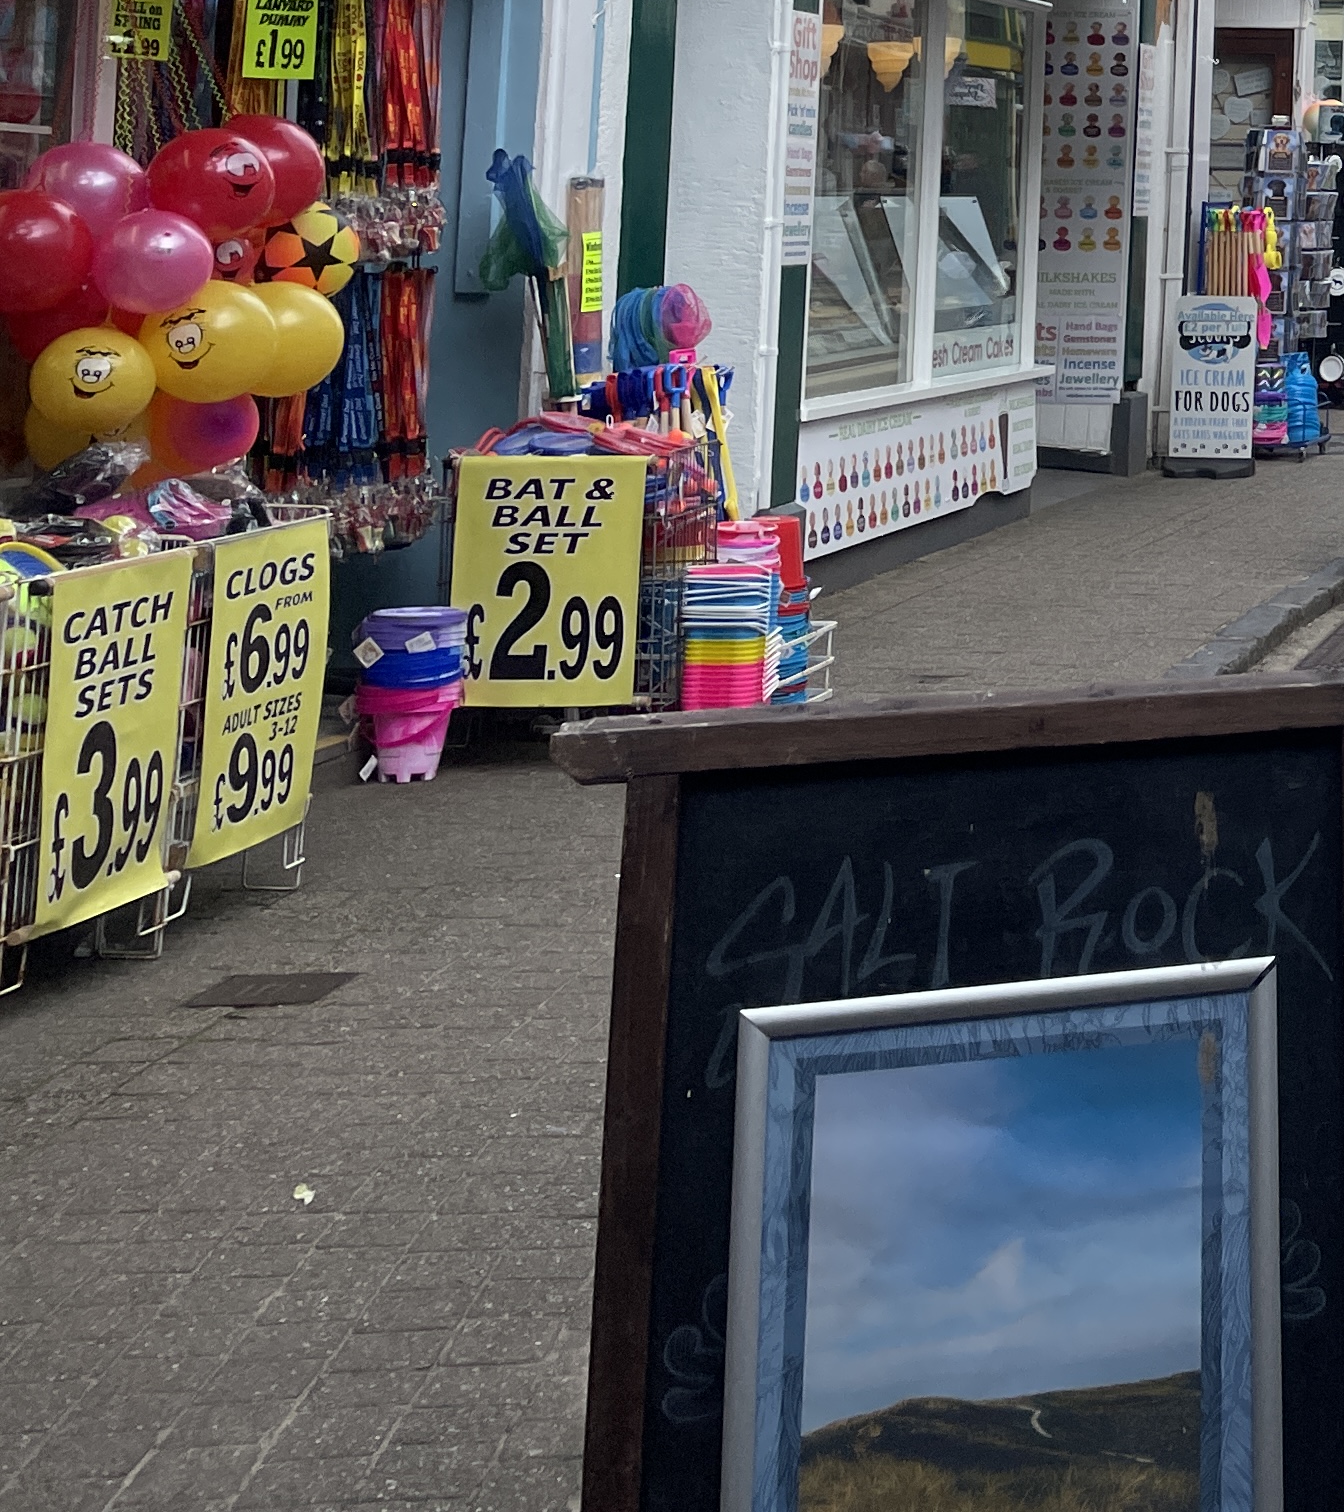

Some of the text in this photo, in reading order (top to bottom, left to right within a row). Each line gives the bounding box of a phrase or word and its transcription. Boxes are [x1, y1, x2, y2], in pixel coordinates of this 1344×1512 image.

[255, 0, 314, 12] LANYARD
[114, 15, 161, 30] STING
[259, 14, 310, 27] DUMMY
[793, 17, 817, 51] Gift
[789, 50, 818, 86] Shop
[1038, 272, 1117, 284] ILKSHAKES
[1066, 322, 1118, 332] Hand Bags
[1177, 311, 1255, 322] Available Here
[1202, 324, 1222, 334] per
[933, 347, 949, 368] esh
[952, 341, 983, 364] Cream
[986, 336, 1014, 358] Cakes
[1064, 359, 1116, 370] Incense
[1059, 373, 1119, 387] Jewellery
[1180, 369, 1245, 387] ICE CREAM
[1175, 390, 1250, 413] FOR DOGS
[485, 478, 616, 500] BAT &
[492, 505, 604, 528] BALL
[503, 533, 589, 555] SET
[225, 551, 315, 600] CLOGS
[275, 591, 313, 610] FROM
[63, 591, 174, 645] CATCH
[463, 561, 623, 681] £2.99
[74, 633, 156, 681] BALL
[221, 604, 310, 701] £6.99
[75, 668, 154, 717] SETS
[222, 692, 302, 736] ADULT SIZES
[268, 717, 298, 742] 3-12
[212, 732, 294, 833] £9.99
[47, 720, 163, 904] £3.99
